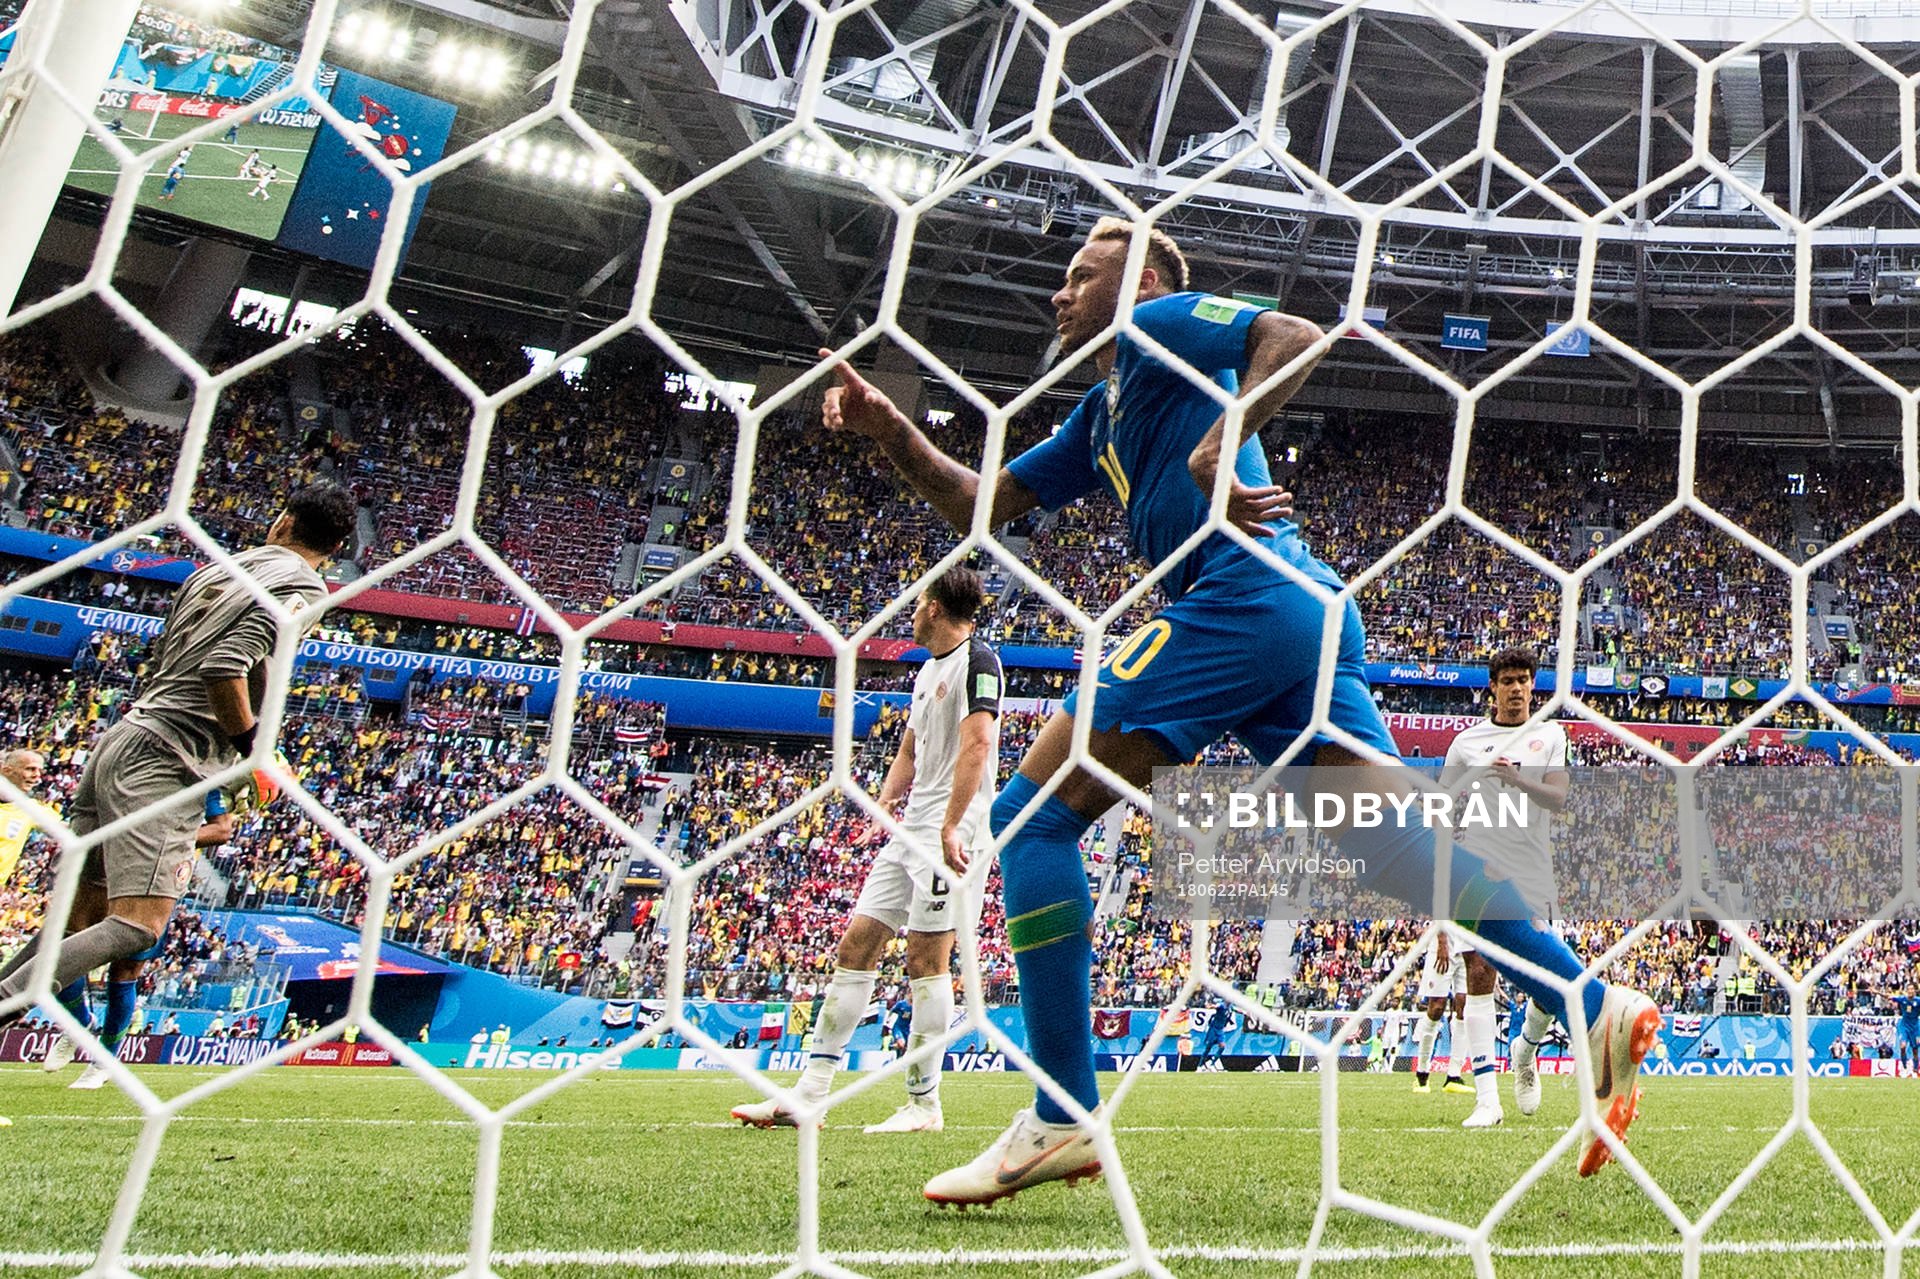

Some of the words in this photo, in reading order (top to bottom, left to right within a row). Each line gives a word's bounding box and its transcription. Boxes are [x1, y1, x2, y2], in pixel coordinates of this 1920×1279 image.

[137, 14, 172, 32] 90:00
[1449, 327, 1481, 340] FIFA
[77, 608, 164, 636] ЧЕМПИО
[325, 645, 425, 669] ФУТБОЛУ
[430, 657, 472, 675] FIFA
[479, 661, 525, 681] 2018
[547, 671, 635, 690] РССИИ
[1390, 666, 1460, 683] #worcup
[464, 1043, 622, 1069] Hisense
[948, 1053, 1006, 1072] VISA
